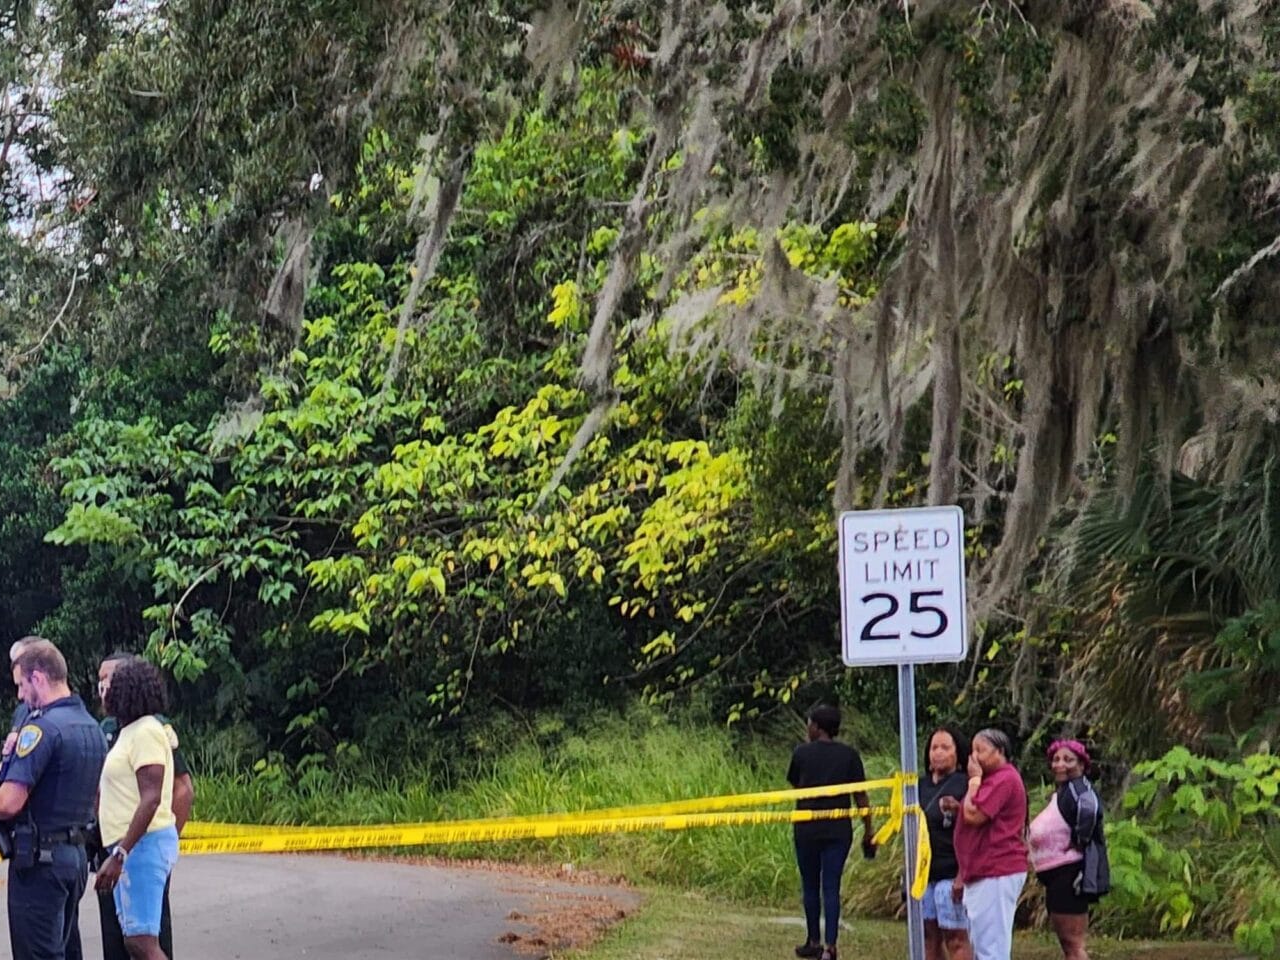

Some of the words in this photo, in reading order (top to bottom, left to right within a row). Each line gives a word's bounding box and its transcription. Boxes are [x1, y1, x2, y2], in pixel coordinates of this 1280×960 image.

[853, 528, 950, 553] SPEED
[865, 559, 939, 583] LIMIT
[860, 588, 948, 641] 25
